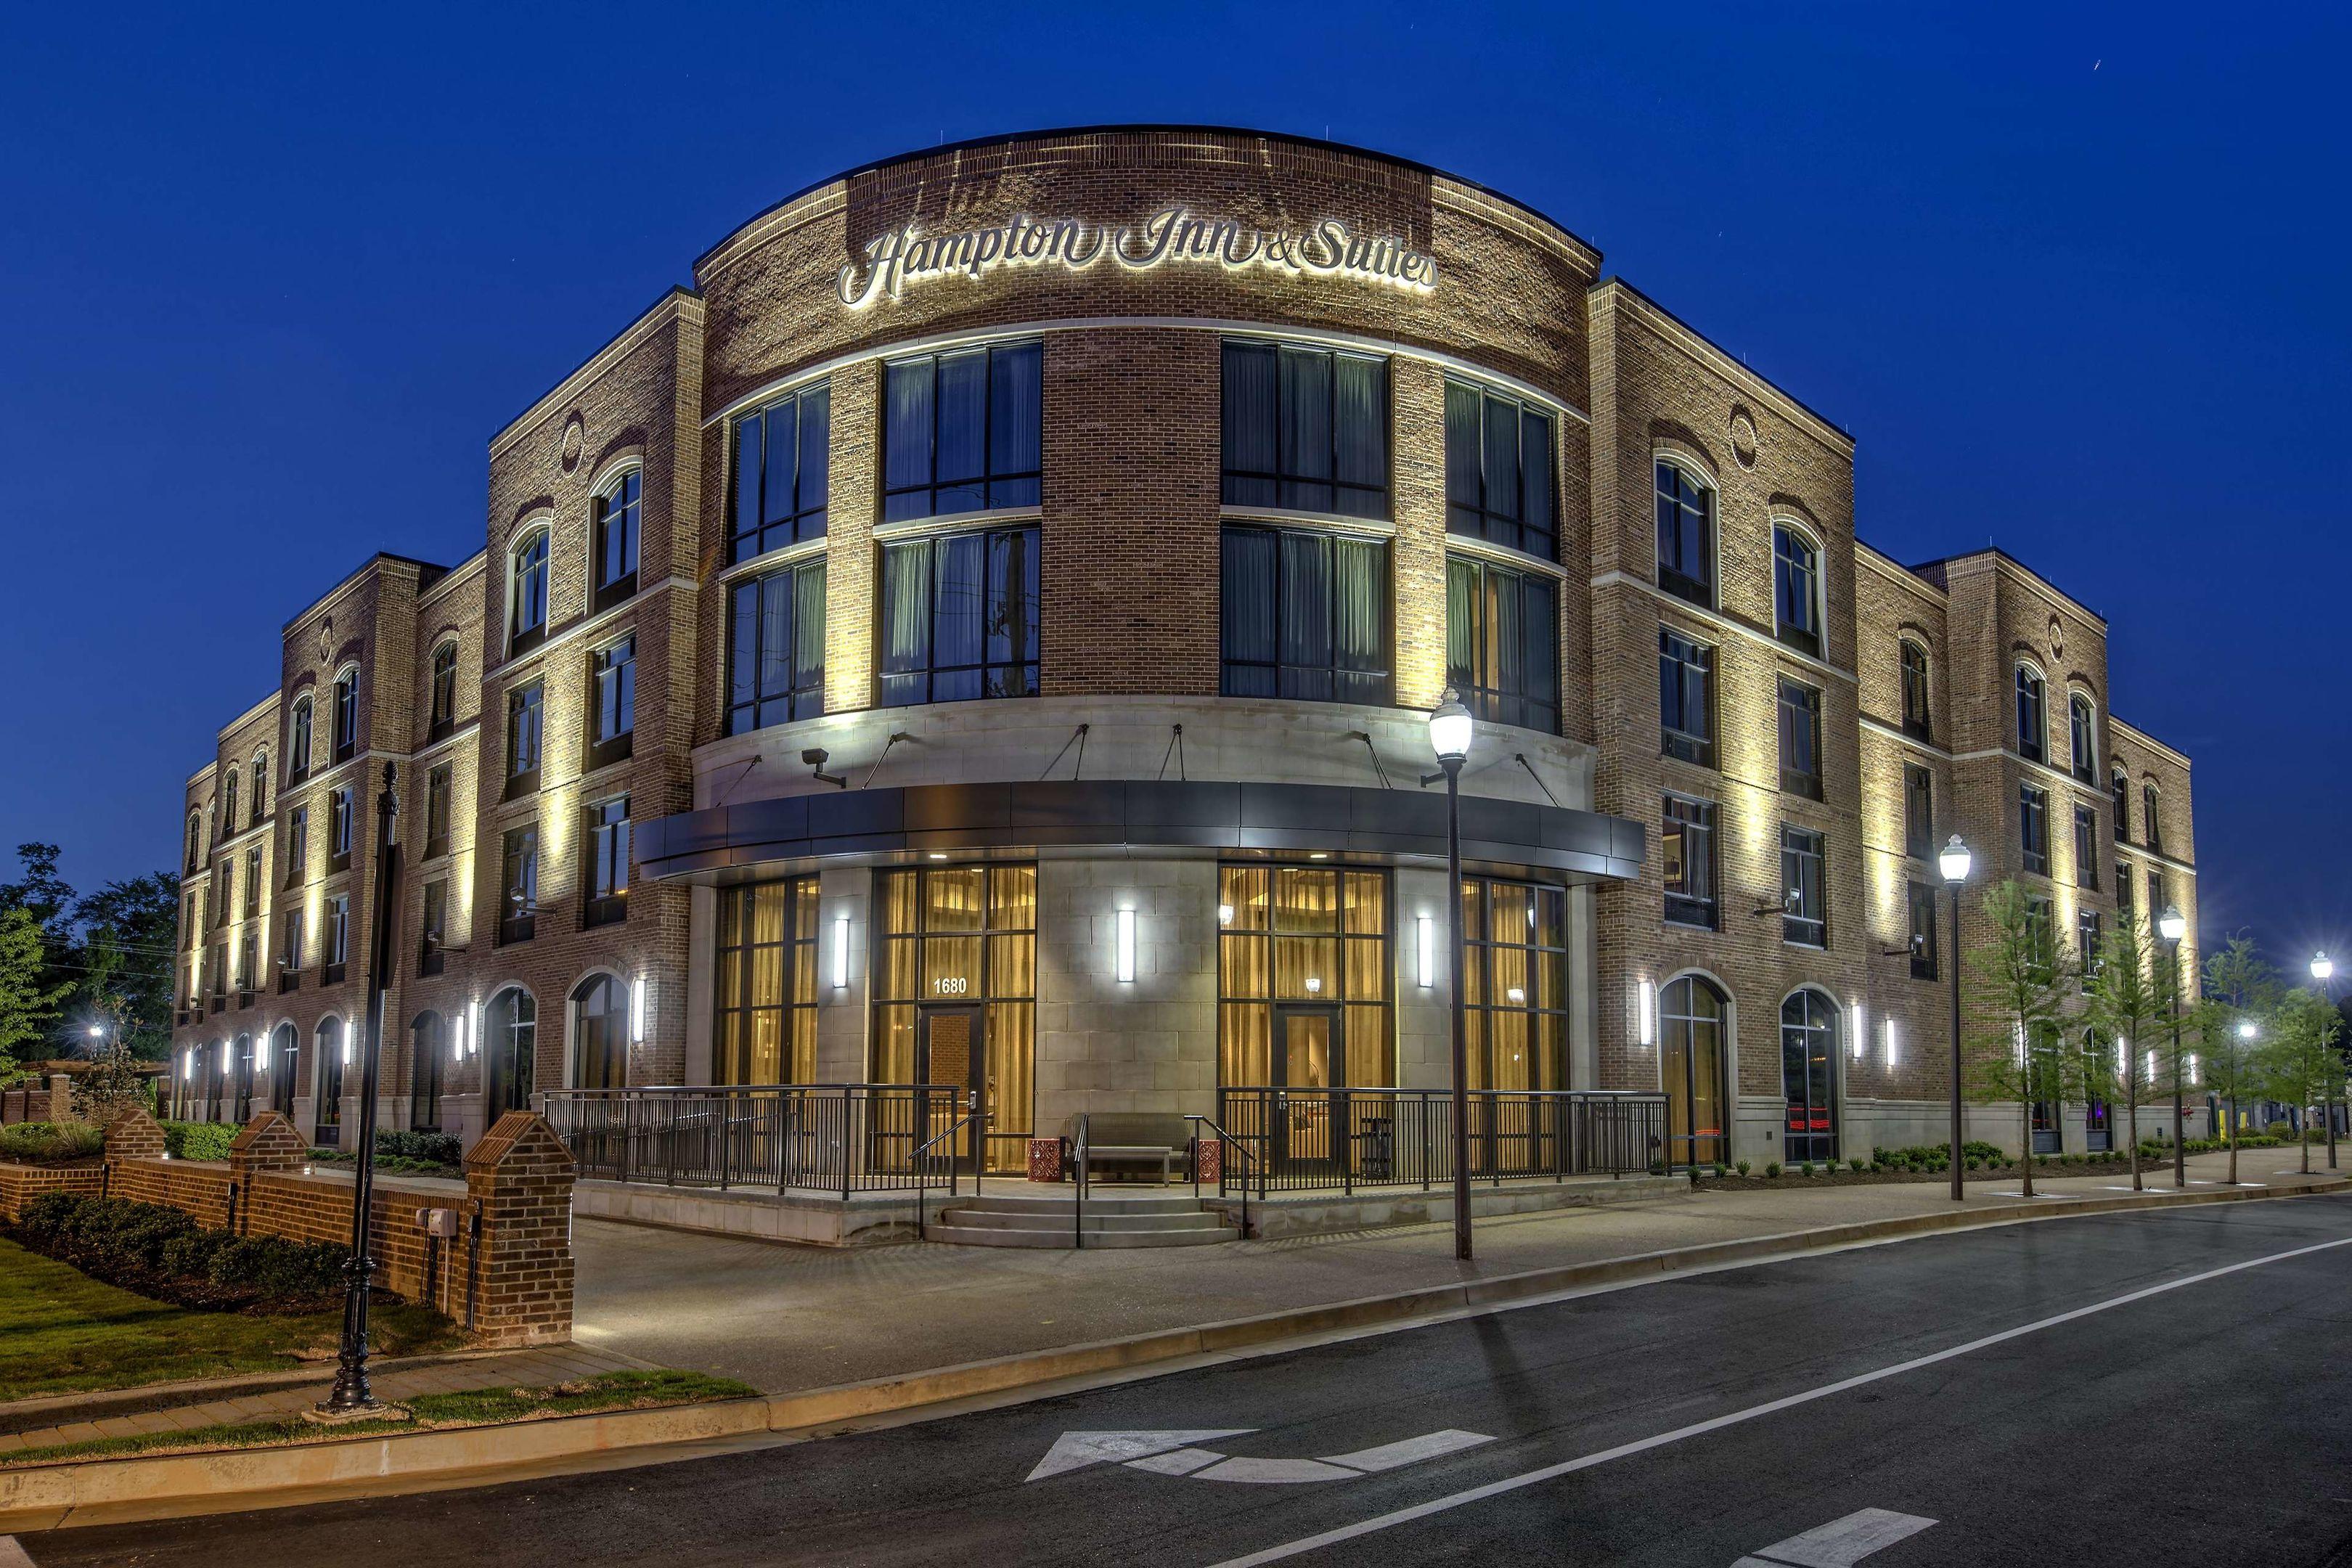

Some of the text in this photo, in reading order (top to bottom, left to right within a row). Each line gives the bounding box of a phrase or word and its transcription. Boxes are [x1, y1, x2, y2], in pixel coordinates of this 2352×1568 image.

[837, 206, 1439, 309] Hampton Inn & Suites
[934, 977, 967, 994] 1680
